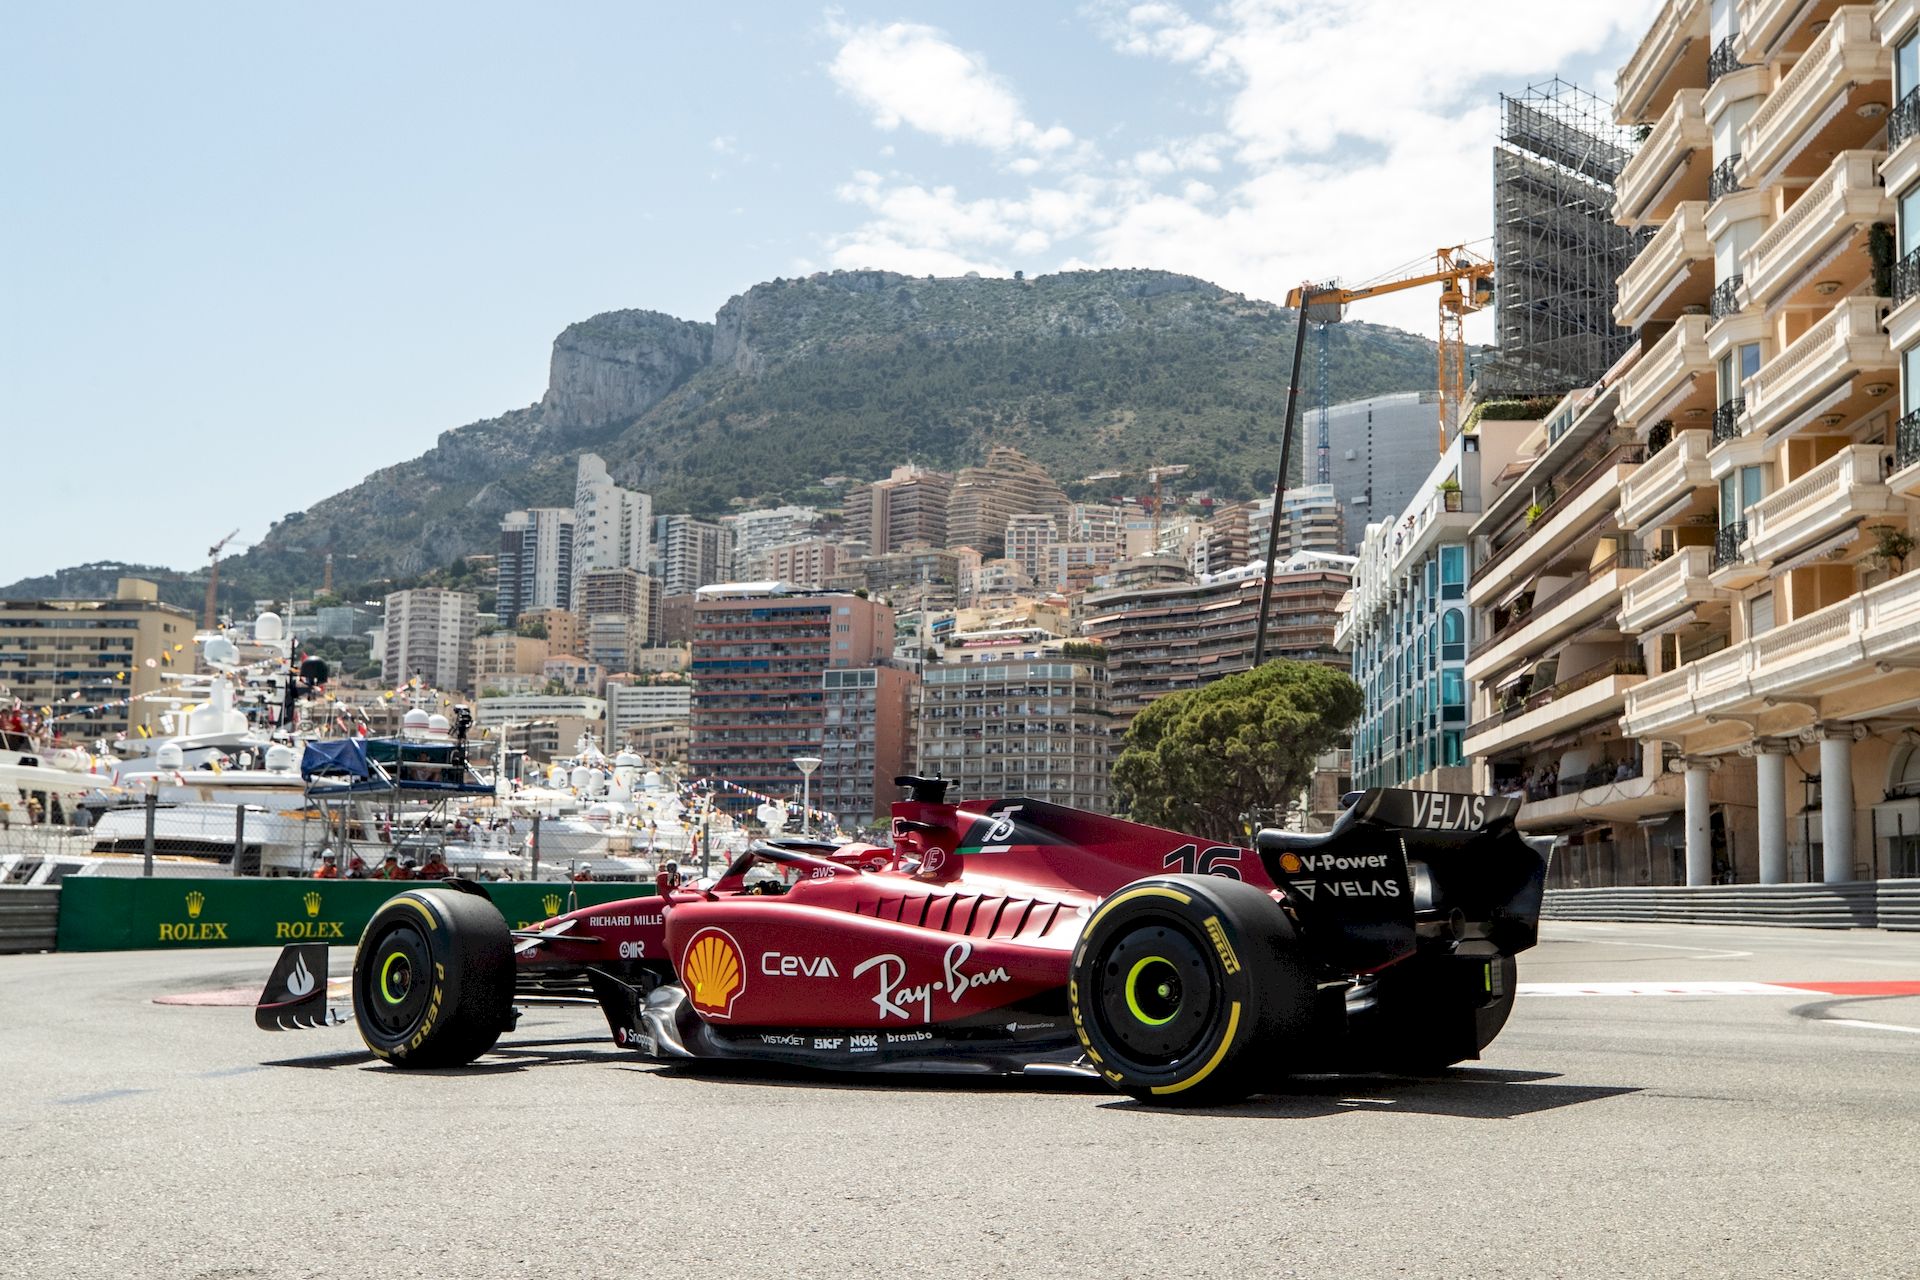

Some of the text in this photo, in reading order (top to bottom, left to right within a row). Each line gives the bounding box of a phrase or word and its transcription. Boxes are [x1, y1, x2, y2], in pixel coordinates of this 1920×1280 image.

[1412, 792, 1485, 831] VELAS
[1163, 843, 1242, 882] 16
[1301, 854, 1388, 872] V-Power
[812, 866, 835, 878] aws
[1323, 879, 1400, 897] VELAS
[589, 914, 663, 927] RICHARD MILLE
[158, 923, 229, 941] ROLEX
[275, 921, 345, 939] ROLEX
[1203, 914, 1241, 975] PIRELLI
[411, 984, 443, 1050] ZERO
[1070, 979, 1104, 1064] ZERO
[814, 1038, 844, 1049] SKF
[850, 1034, 878, 1047] NGK
[886, 1031, 933, 1043] brembo
